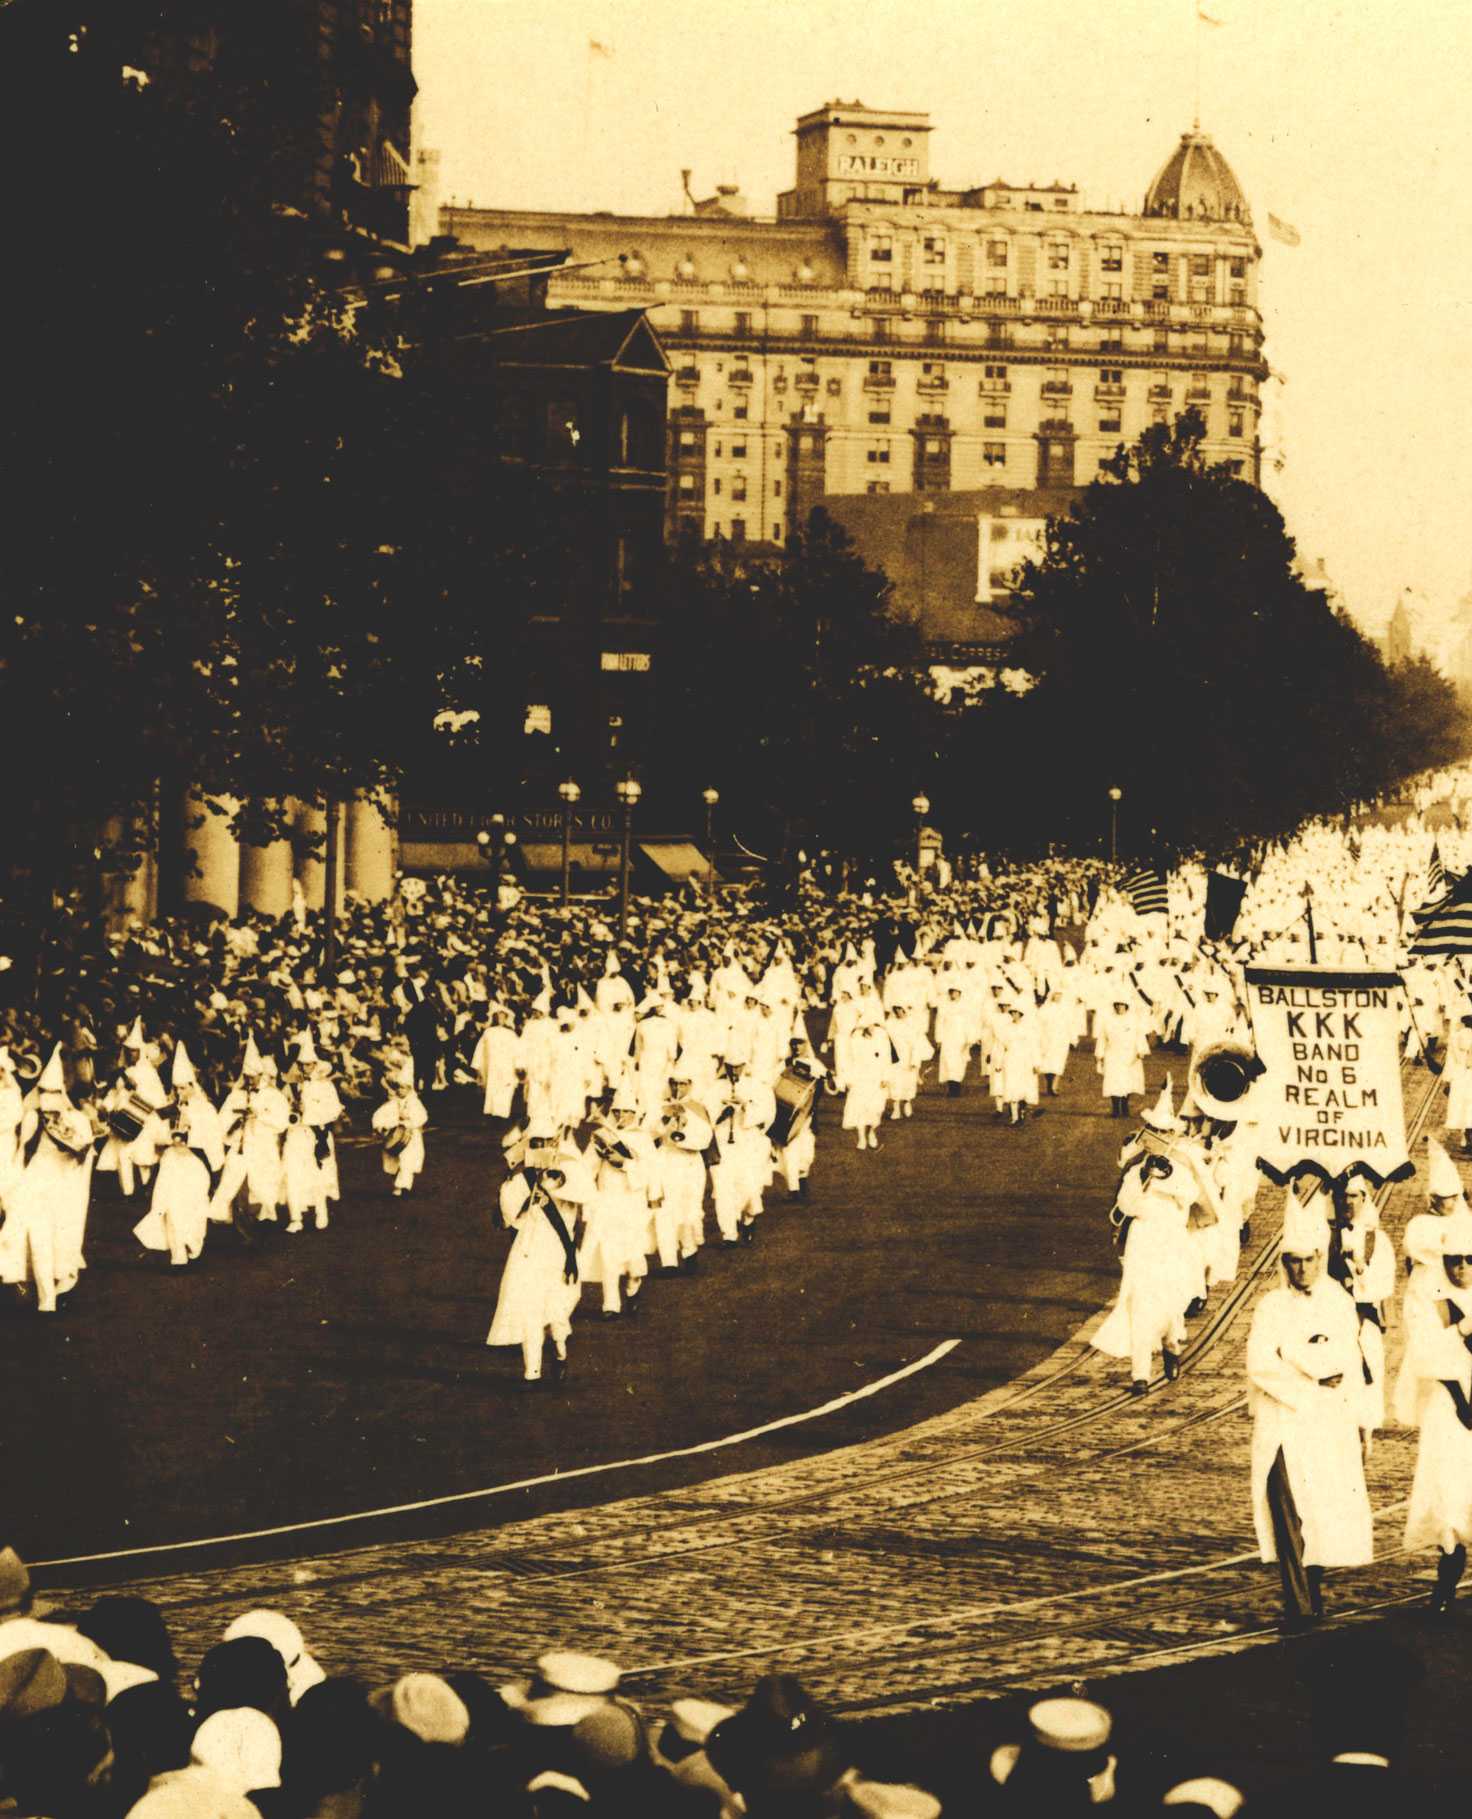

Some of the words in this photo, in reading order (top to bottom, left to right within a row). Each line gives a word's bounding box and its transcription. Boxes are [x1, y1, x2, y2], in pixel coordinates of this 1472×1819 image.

[838, 155, 919, 177] RALEIGH
[1258, 986, 1388, 1009] BALLSTON
[1293, 1042, 1360, 1062] BAND
[1297, 1065, 1328, 1084] No
[1342, 1066, 1357, 1085] 6
[1285, 1085, 1378, 1108] REALM
[1317, 1110, 1345, 1124] OF
[1278, 1126, 1388, 1148] VIRGINIA
